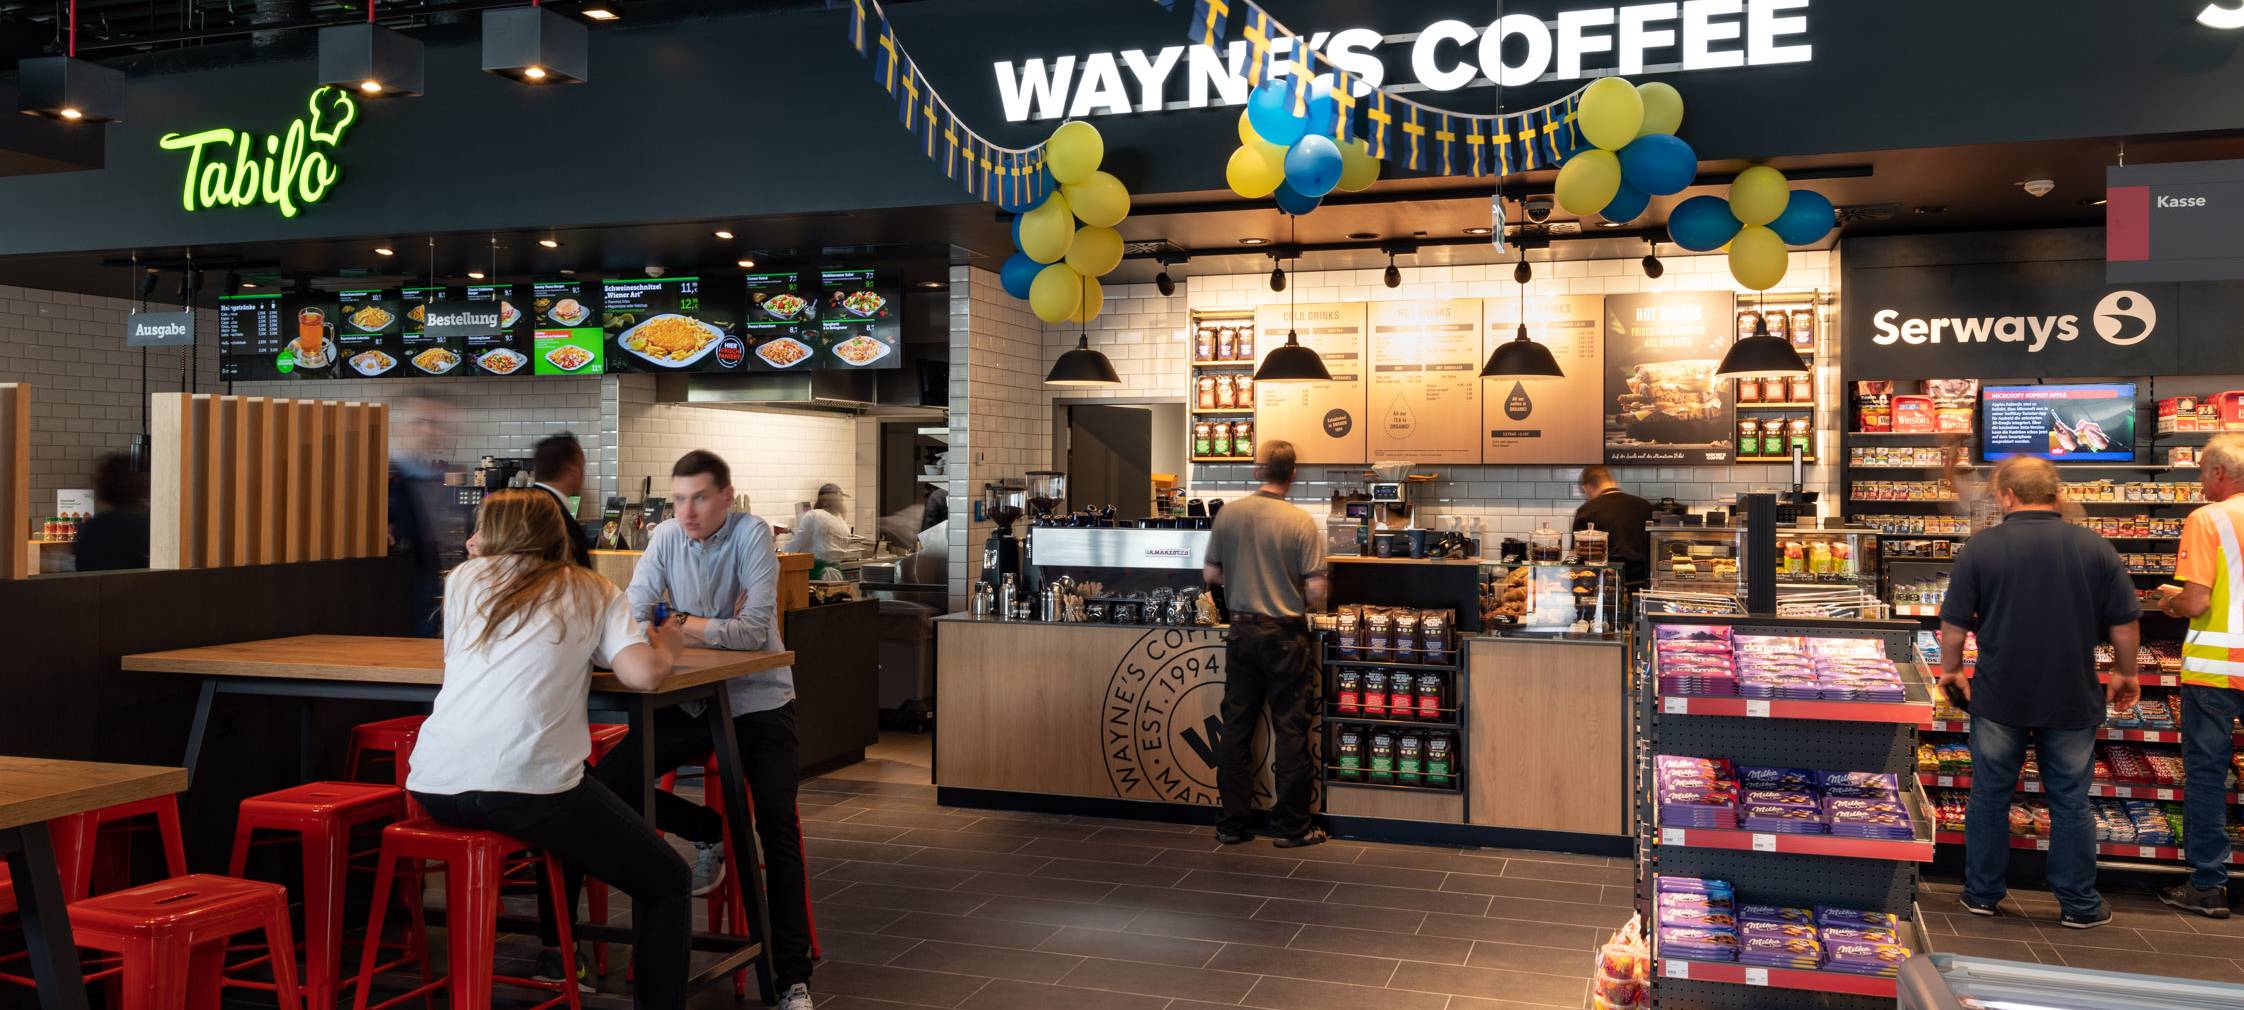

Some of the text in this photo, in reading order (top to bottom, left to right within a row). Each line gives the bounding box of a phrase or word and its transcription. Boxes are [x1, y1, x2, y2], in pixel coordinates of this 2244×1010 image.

[995, 0, 1812, 122] WAYNE'S COFFEE
[160, 117, 337, 217] Tabilo
[2157, 195, 2207, 208] Kasse
[604, 283, 662, 297] Schweineschnitzel
[426, 311, 499, 328] Bestellung
[1308, 311, 1340, 320] DRINKS
[1636, 307, 1656, 321] HOT
[135, 322, 187, 340] Ausgabe
[1873, 309, 2079, 352] Serways
[1898, 415, 1926, 425] Winston
[1941, 420, 1970, 430] Winston
[1159, 653, 1220, 694] 1994
[1110, 662, 1147, 793] WAYNE'S
[1156, 766, 1223, 804] MAD
